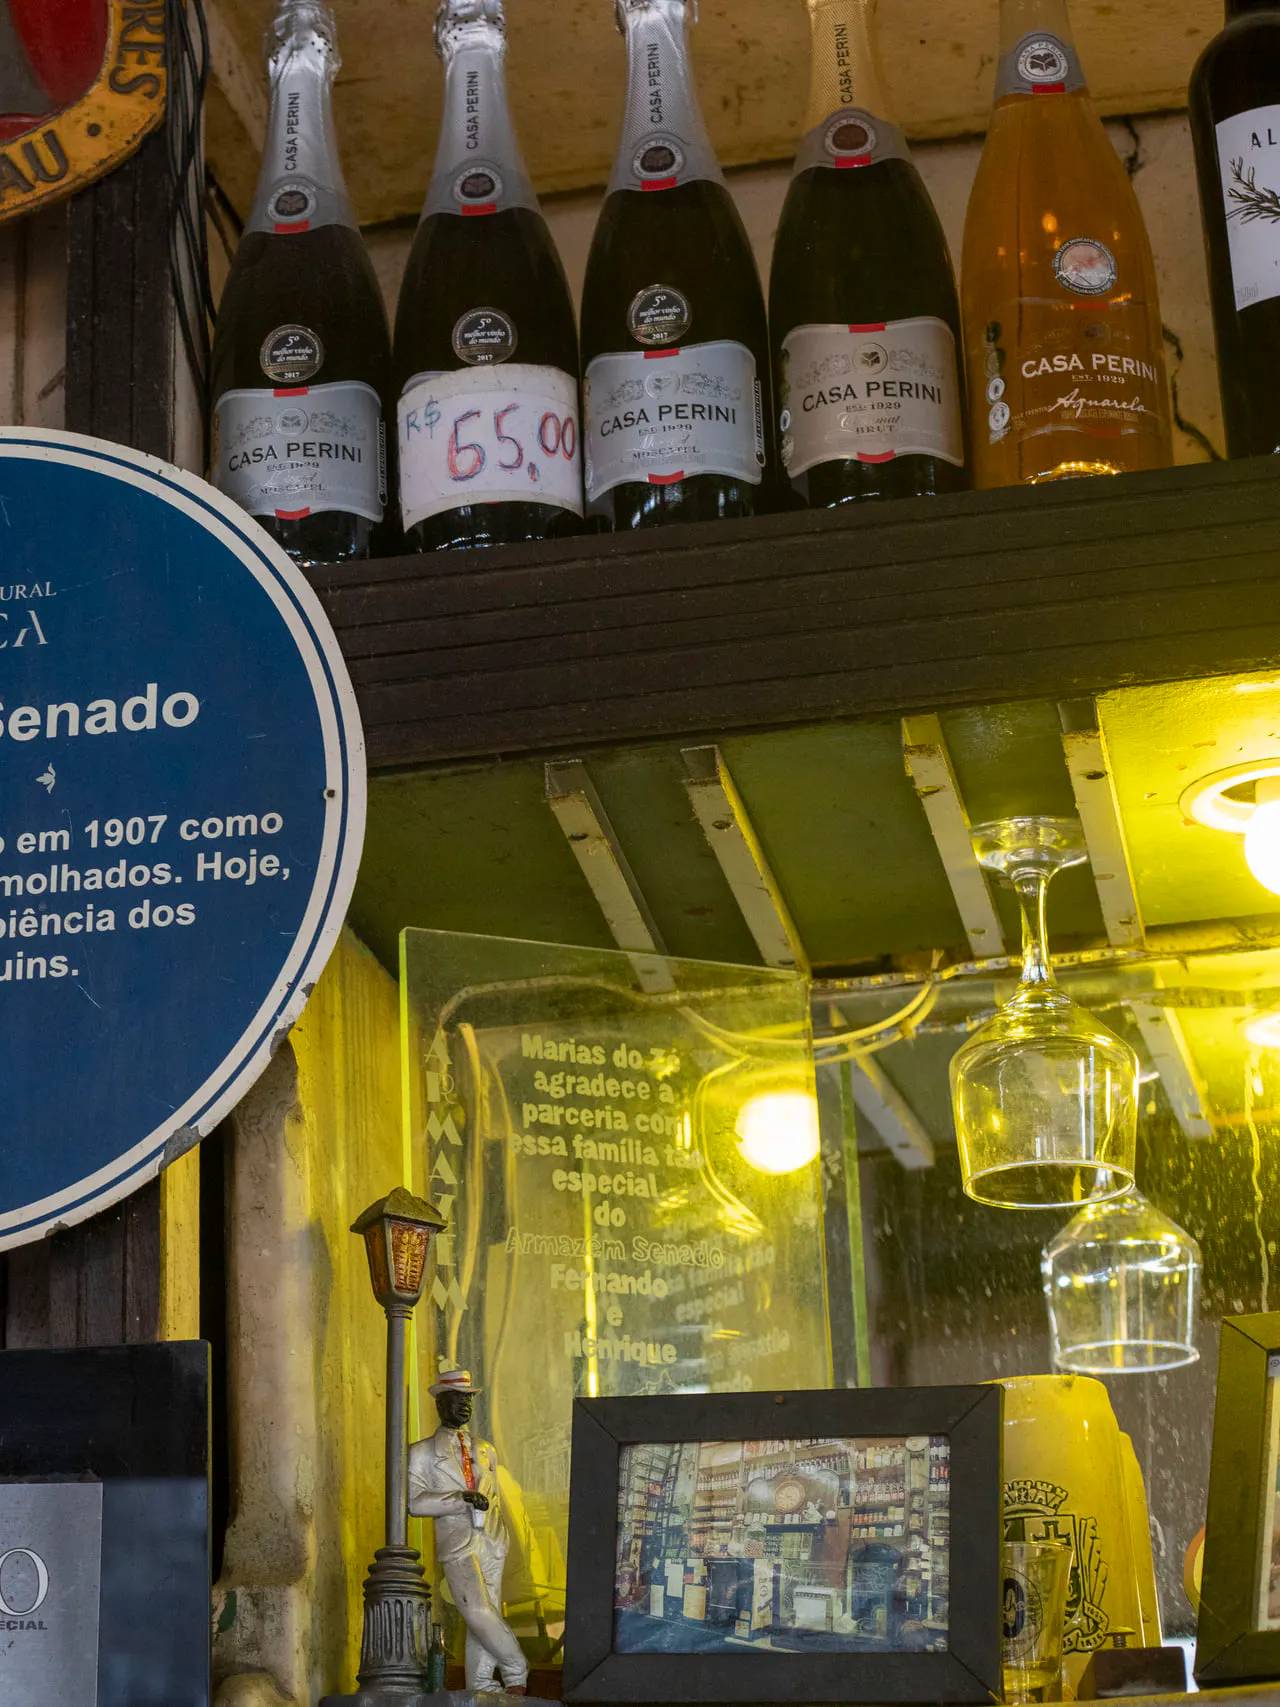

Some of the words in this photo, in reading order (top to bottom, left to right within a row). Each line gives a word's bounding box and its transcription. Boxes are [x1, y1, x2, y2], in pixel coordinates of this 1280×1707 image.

[109, 0, 167, 99] RES
[835, 23, 848, 66] PERINI
[647, 43, 661, 86] PERINI
[466, 70, 479, 113] PERINI
[840, 67, 854, 104] CASA
[286, 92, 301, 135] PERINI
[649, 87, 663, 124] CASA
[465, 113, 479, 150] CASA
[284, 134, 299, 172] CASA
[651, 331, 669, 340] 2017
[283, 371, 300, 379] 2017
[1022, 354, 1086, 378] CASA
[1091, 353, 1158, 385] PERINI
[1097, 374, 1125, 384] 1929
[802, 384, 858, 412] CASA
[865, 380, 942, 405] PERINI
[870, 402, 902, 411] 1929
[600, 408, 650, 438] CASA
[658, 403, 737, 425] PERINI
[228, 444, 278, 472] CASA
[286, 442, 363, 464] PERINI
[405, 396, 442, 442] R$
[447, 402, 576, 483] 65,00
[16, 829, 70, 854] em
[84, 814, 168, 849] 1907
[179, 812, 283, 841] como
[196, 849, 290, 886] Hoje,
[128, 899, 196, 929] dos
[521, 1033, 607, 1066] Marias
[612, 1043, 643, 1070] do
[533, 1069, 652, 1099] agradece
[658, 1083, 675, 1104] a
[521, 1102, 629, 1132] parceria
[510, 1132, 569, 1157] essa
[572, 1133, 660, 1167] família
[551, 1168, 659, 1199] especial
[593, 1200, 626, 1228] do
[631, 1235, 725, 1269] Senado
[549, 1263, 669, 1298] Fernando
[606, 1304, 624, 1327] e
[563, 1329, 678, 1368] Henrique
